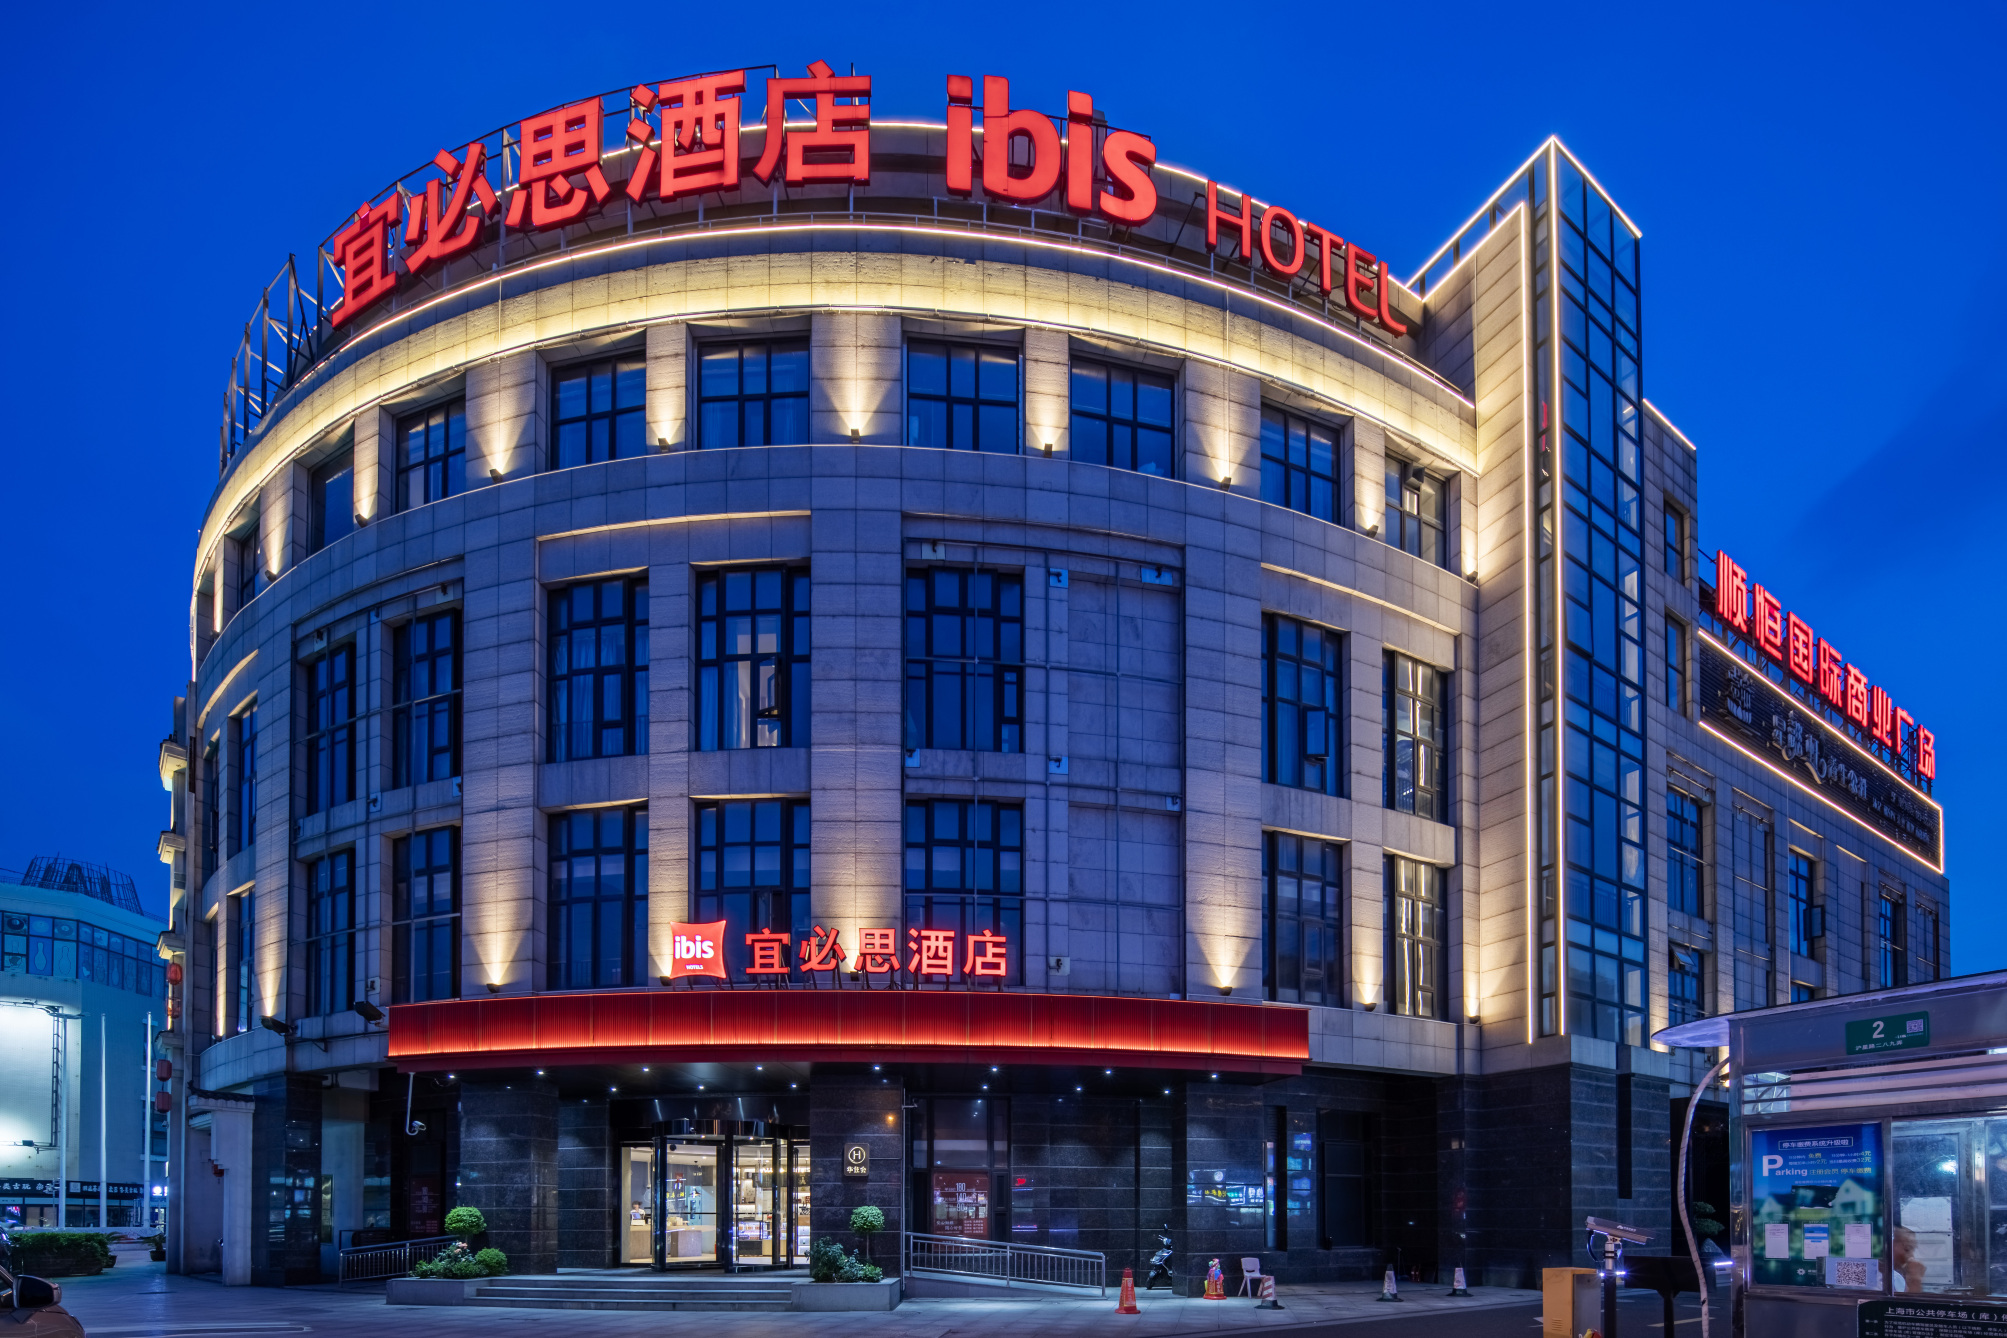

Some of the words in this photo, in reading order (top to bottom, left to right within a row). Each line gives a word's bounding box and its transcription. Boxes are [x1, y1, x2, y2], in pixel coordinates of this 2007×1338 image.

[332, 59, 871, 329] 宜必思酒店
[946, 74, 1157, 227] ibis
[1205, 180, 1408, 338] HOTEL
[1716, 549, 1936, 780] 顺恒国际商业广场
[674, 934, 715, 960] ibis
[745, 925, 1007, 977] 宜必思酒店
[1872, 1020, 1885, 1039] 2
[1762, 1154, 1808, 1177] Parking
[0, 1182, 31, 1191] 类古玩
